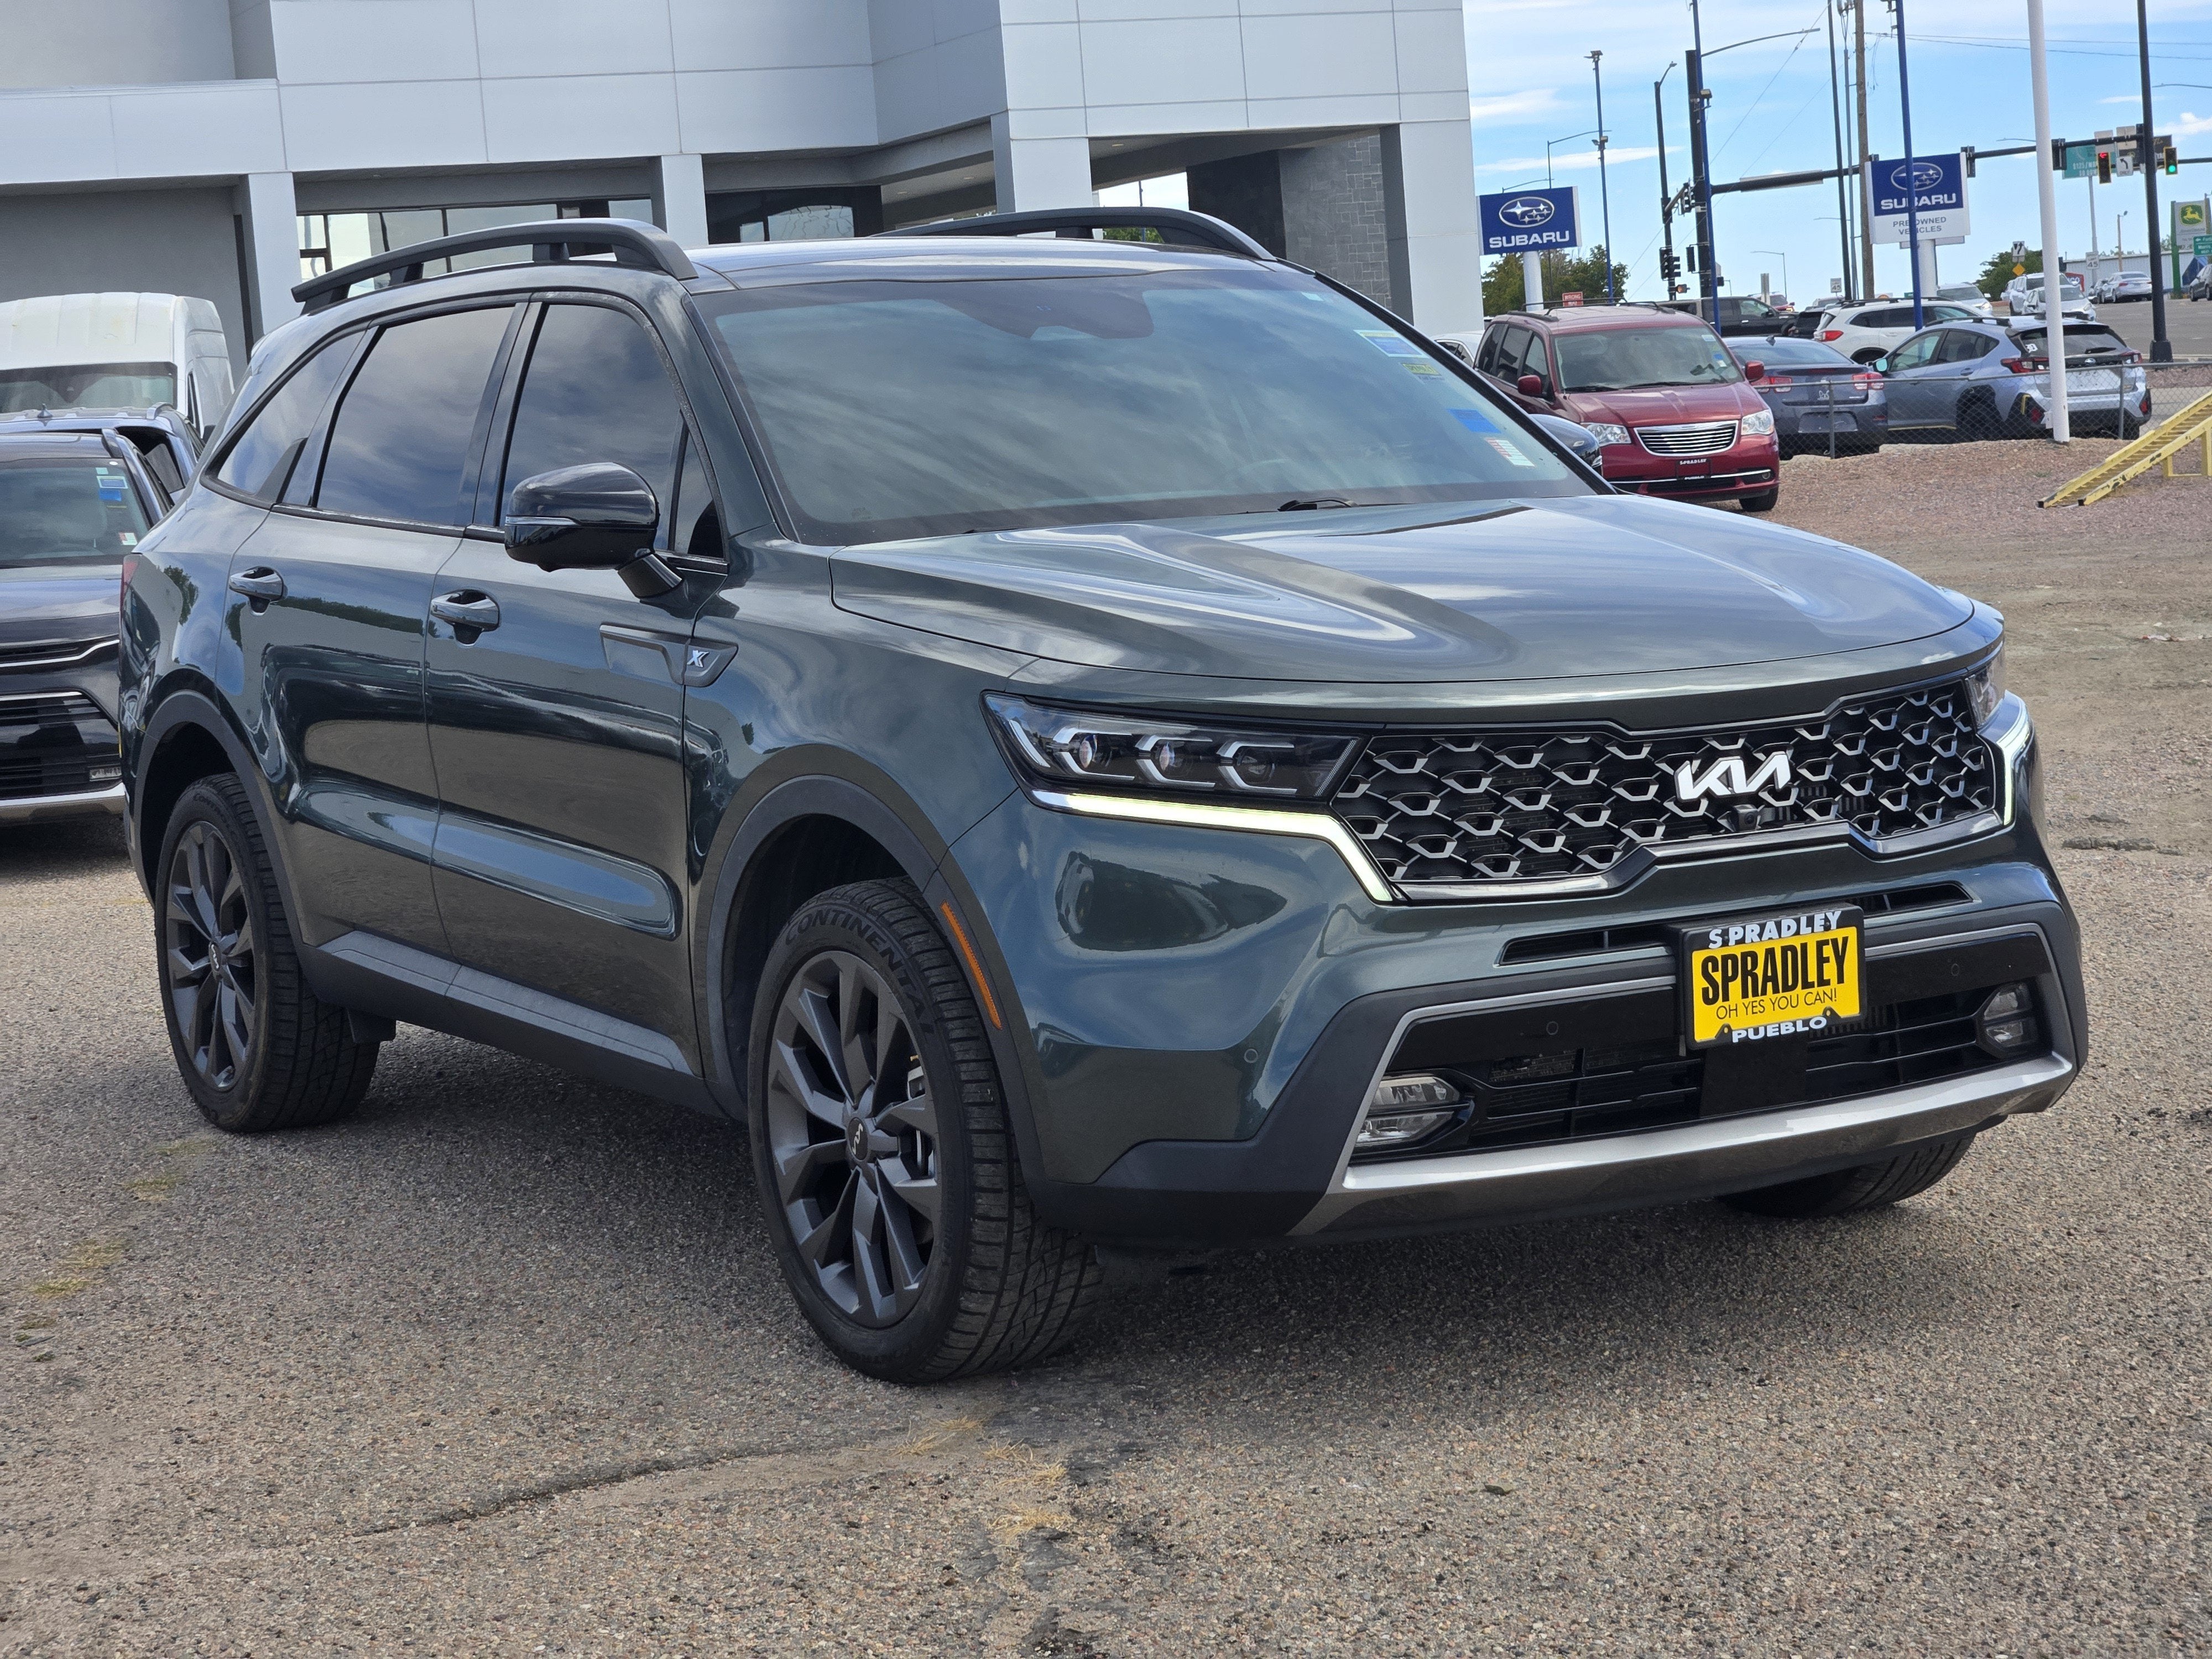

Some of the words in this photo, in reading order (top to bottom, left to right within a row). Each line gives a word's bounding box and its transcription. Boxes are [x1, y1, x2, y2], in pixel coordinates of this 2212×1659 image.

[1489, 231, 1569, 248] SUBARU
[1898, 226, 1942, 234] VEICLES
[1708, 911, 1841, 949] SPRADLEY
[1701, 936, 1849, 1006] SPRADLEY
[1716, 1003, 1738, 1020] OH
[1742, 999, 1765, 1016] YES
[1769, 994, 1799, 1011] YOU
[1804, 988, 1837, 1006] CAN!
[1732, 1016, 1827, 1043] PUEBLO
